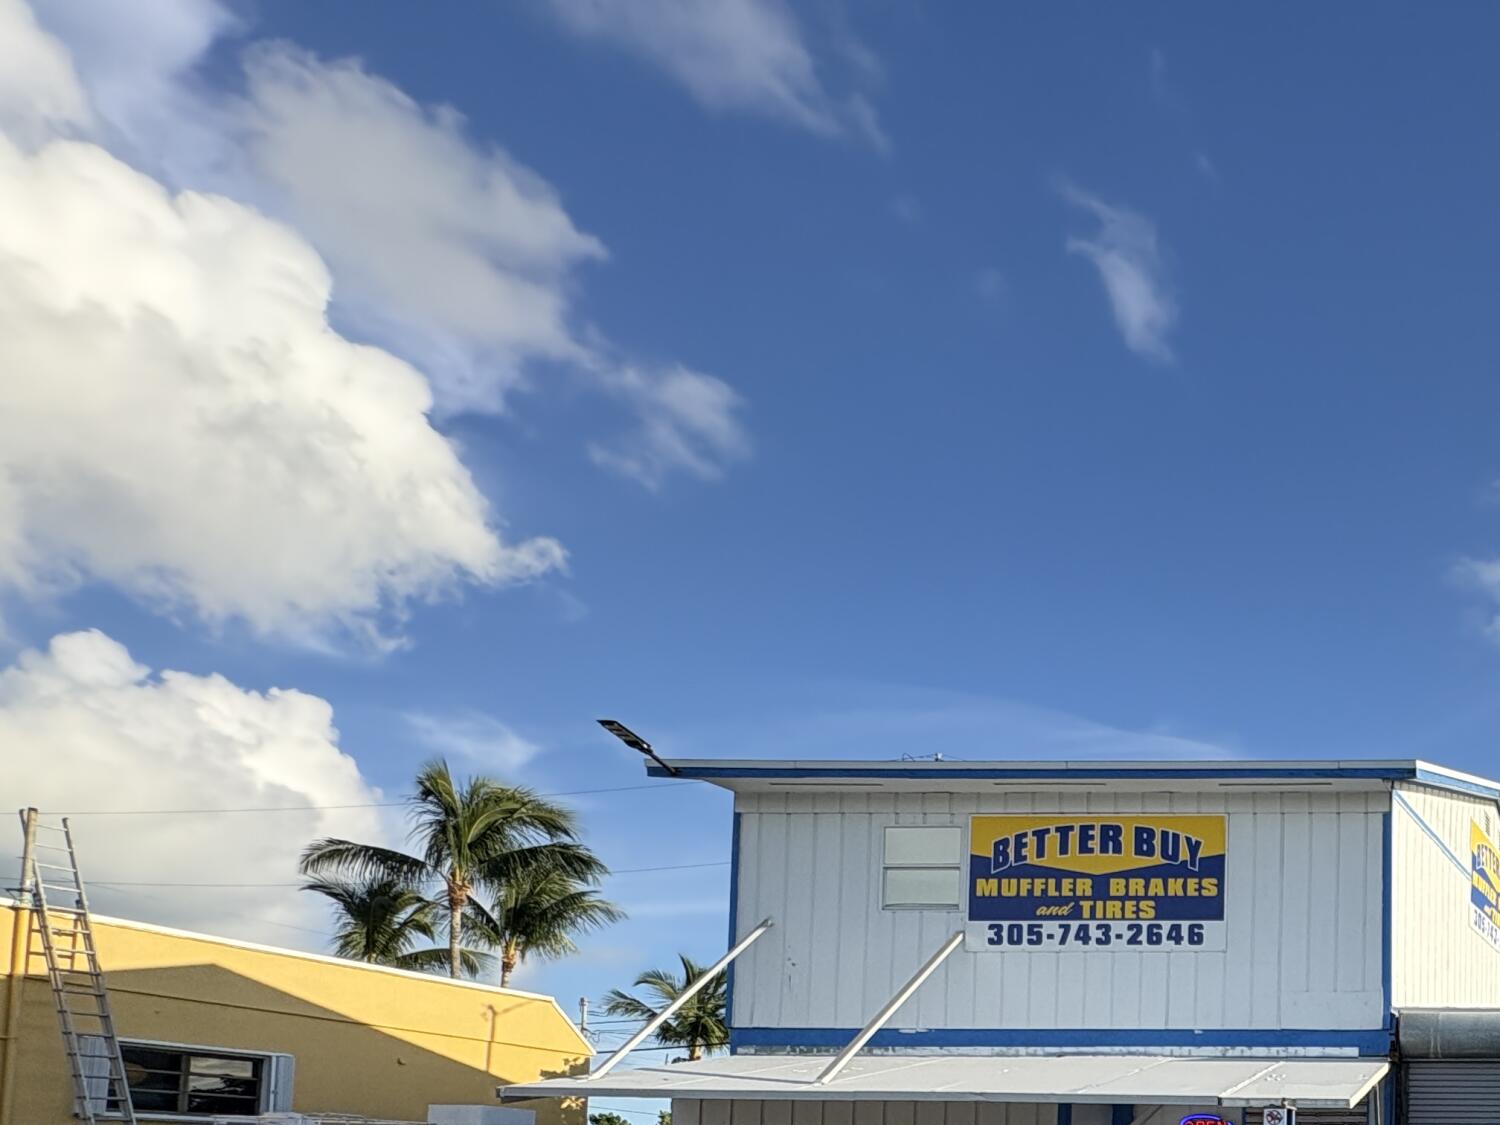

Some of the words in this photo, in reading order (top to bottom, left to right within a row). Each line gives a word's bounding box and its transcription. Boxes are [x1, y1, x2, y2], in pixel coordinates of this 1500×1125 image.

[991, 823, 1123, 874] BETTER
[1132, 825, 1204, 872] BUY
[975, 878, 1093, 897] MUFFLER
[1109, 878, 1218, 897] BRAKES
[1036, 902, 1075, 916] and
[1079, 900, 1156, 919] TIRES
[987, 923, 1204, 946] 305-743-2646
